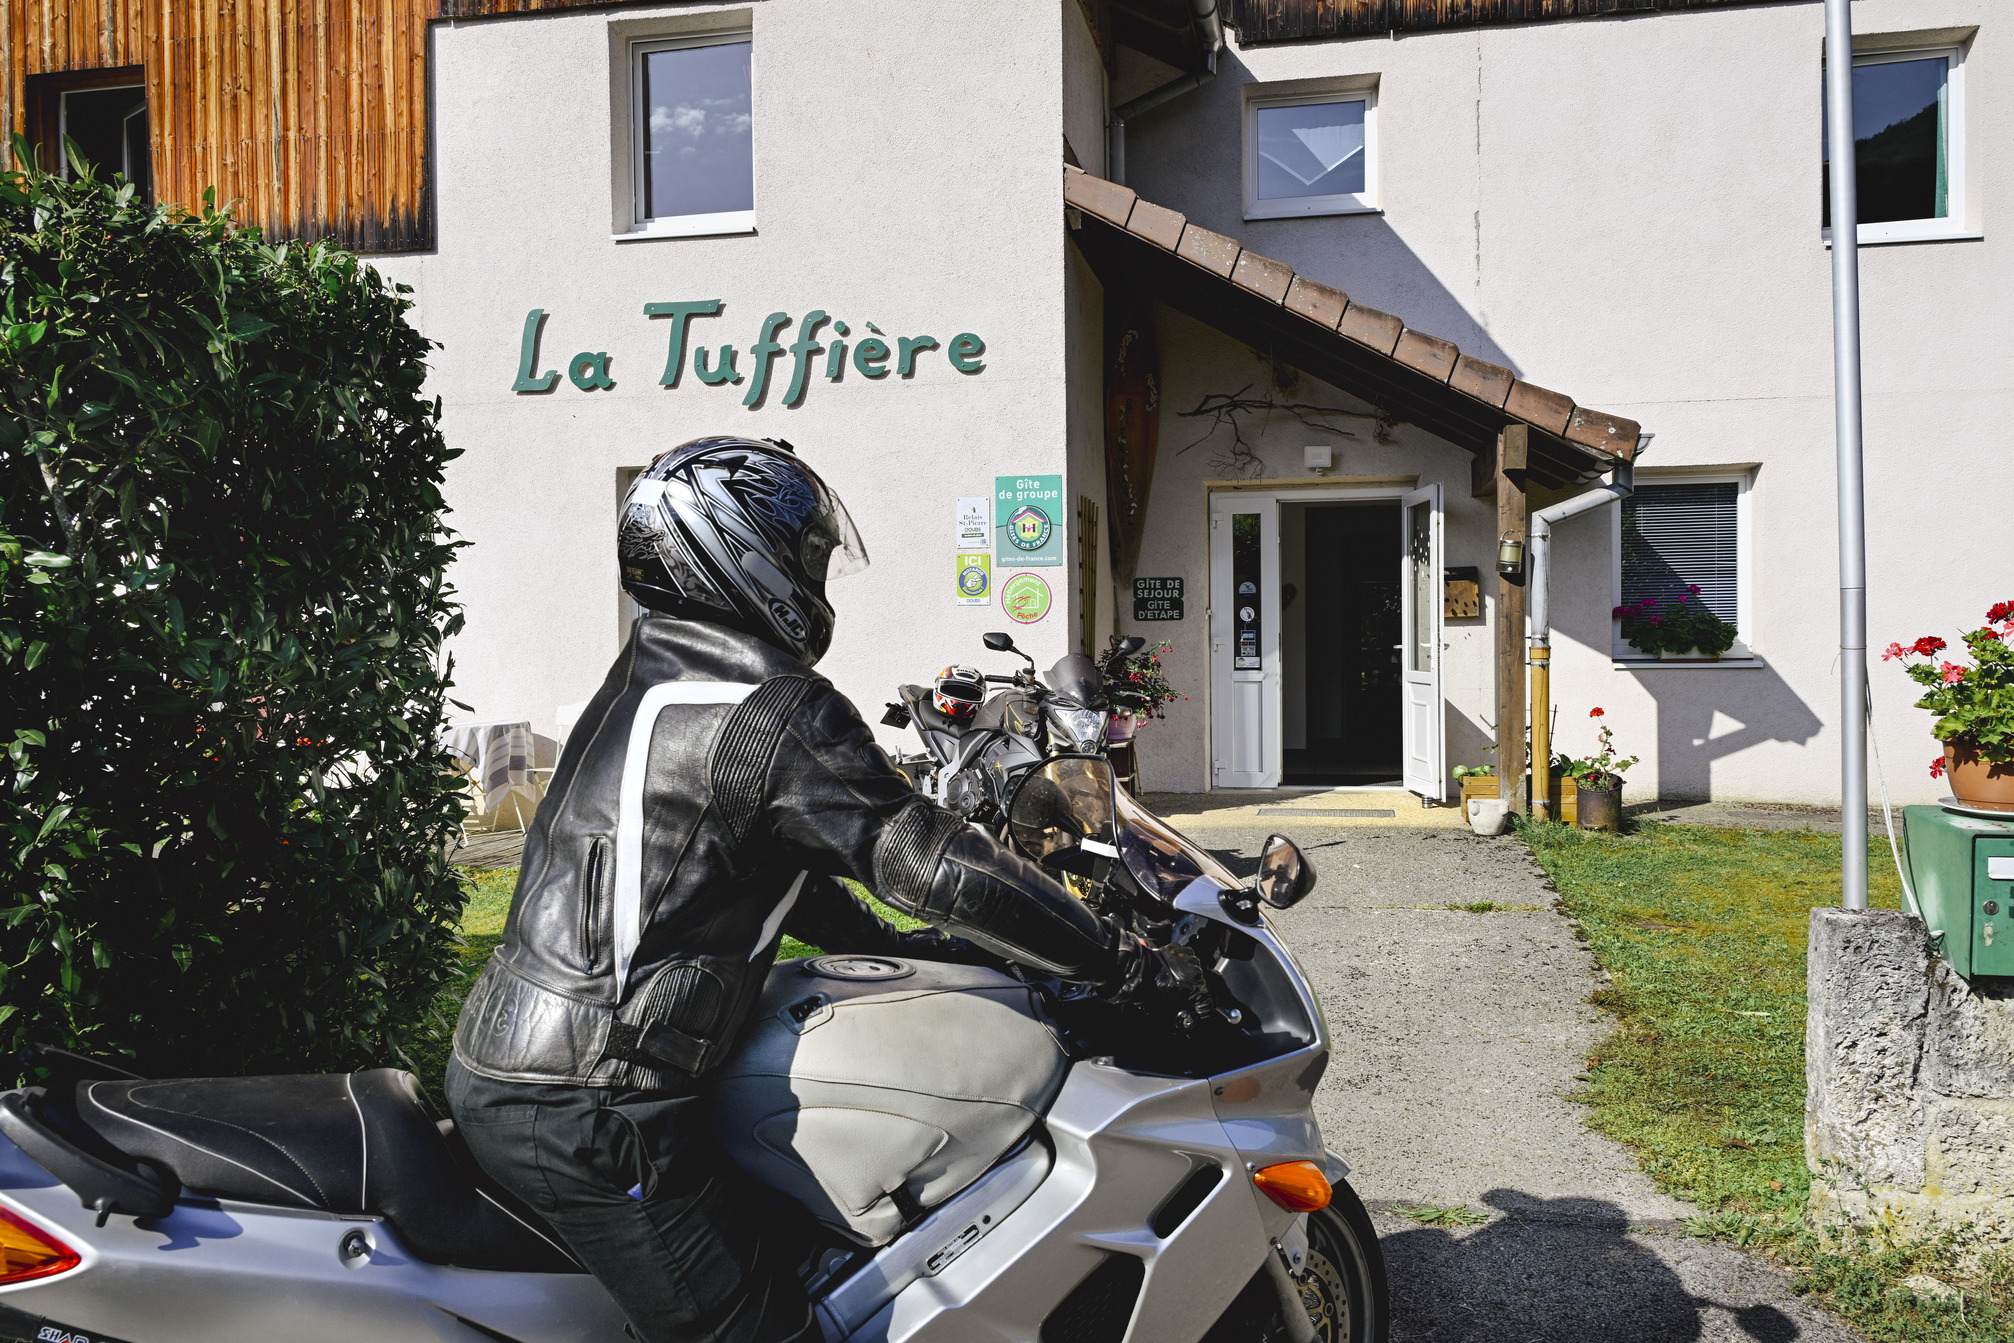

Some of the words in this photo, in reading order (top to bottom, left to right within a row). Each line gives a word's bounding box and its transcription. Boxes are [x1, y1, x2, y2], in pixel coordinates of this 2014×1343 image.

[511, 308, 614, 392] La
[643, 298, 986, 406] Tuffière
[1016, 478, 1040, 489] Gîte
[998, 489, 1013, 500] de
[1016, 490, 1058, 501] groupe
[1032, 524, 1049, 547] FRANCE
[964, 556, 982, 566] ICI
[1166, 580, 1180, 588] DE
[1005, 577, 1041, 604] Hébergement
[1137, 589, 1180, 598] SEJOUR
[1017, 611, 1039, 620] Pêche
[1138, 610, 1180, 619] D'ETAPE
[773, 604, 805, 637] HJC
